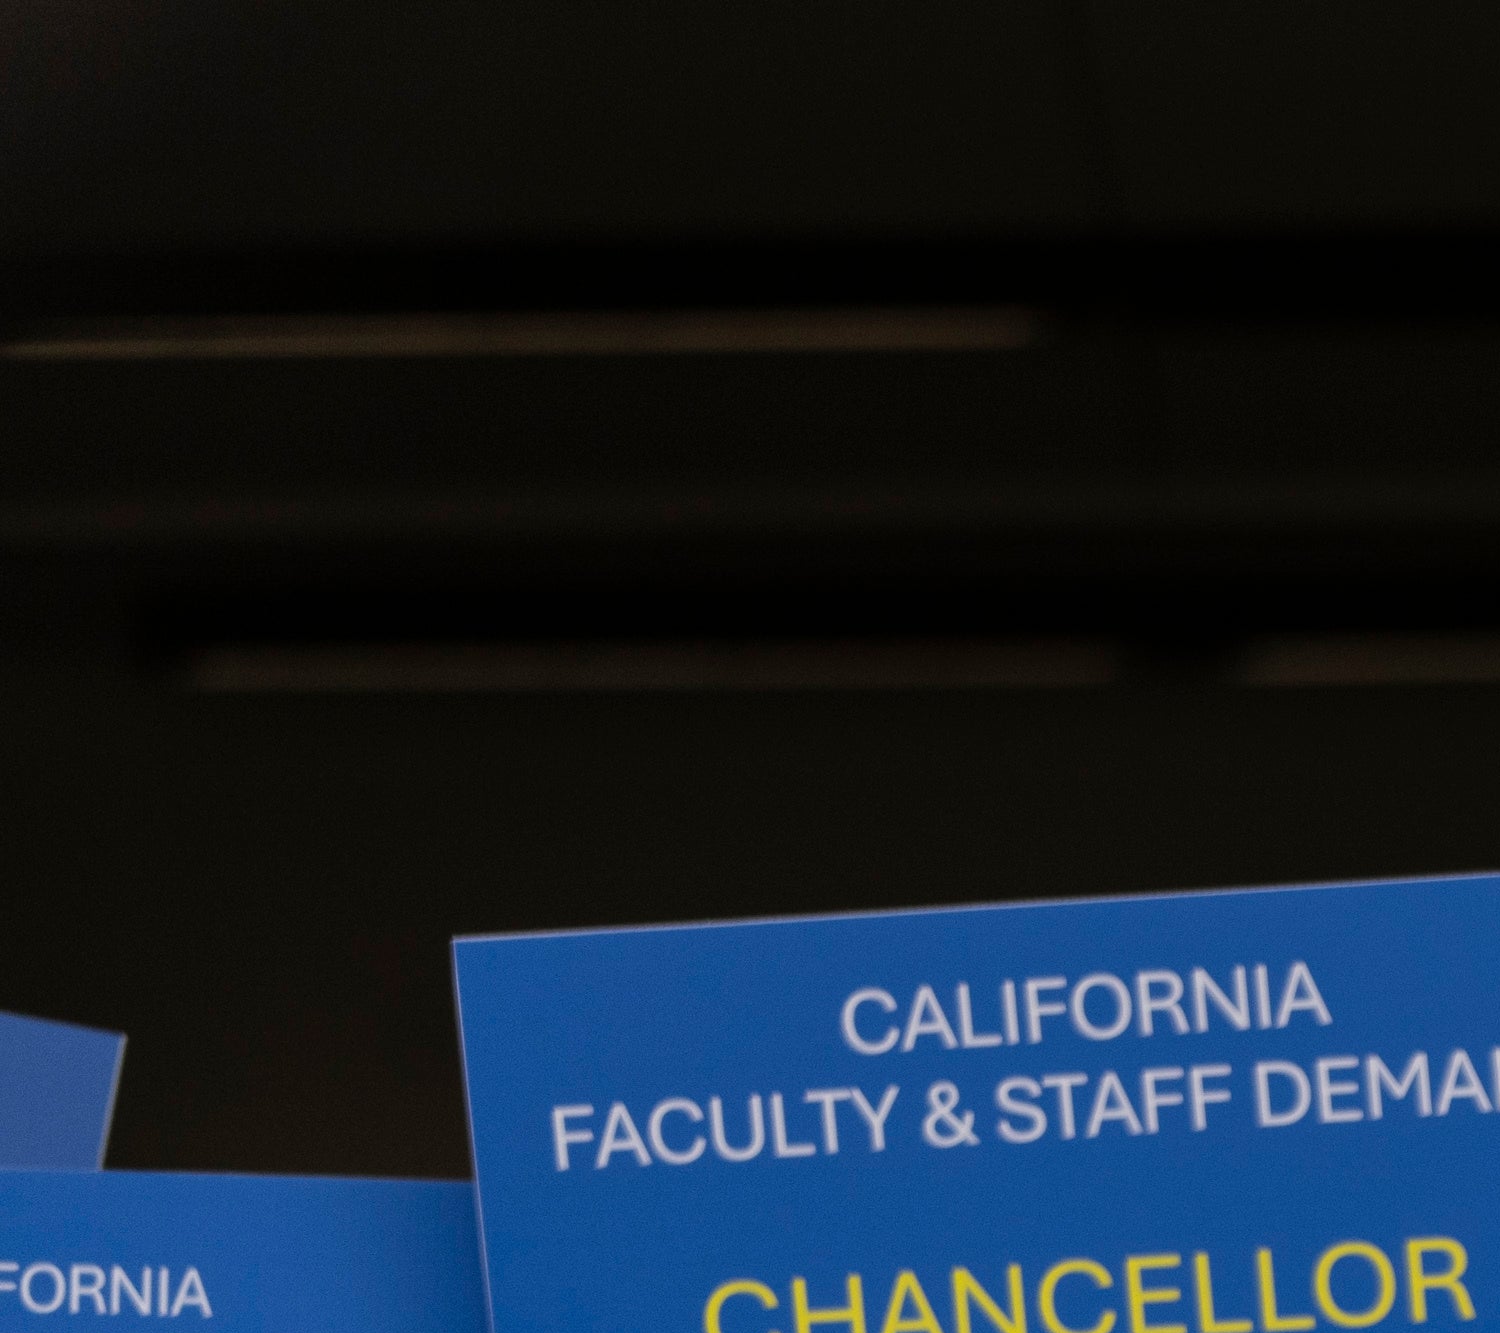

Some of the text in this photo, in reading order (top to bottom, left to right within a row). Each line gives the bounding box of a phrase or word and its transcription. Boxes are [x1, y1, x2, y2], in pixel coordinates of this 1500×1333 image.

[841, 960, 1334, 1058] CALIFORNIA
[551, 1085, 900, 1172] FACULTY
[922, 1081, 980, 1149] &
[995, 1063, 1233, 1144] STAFF
